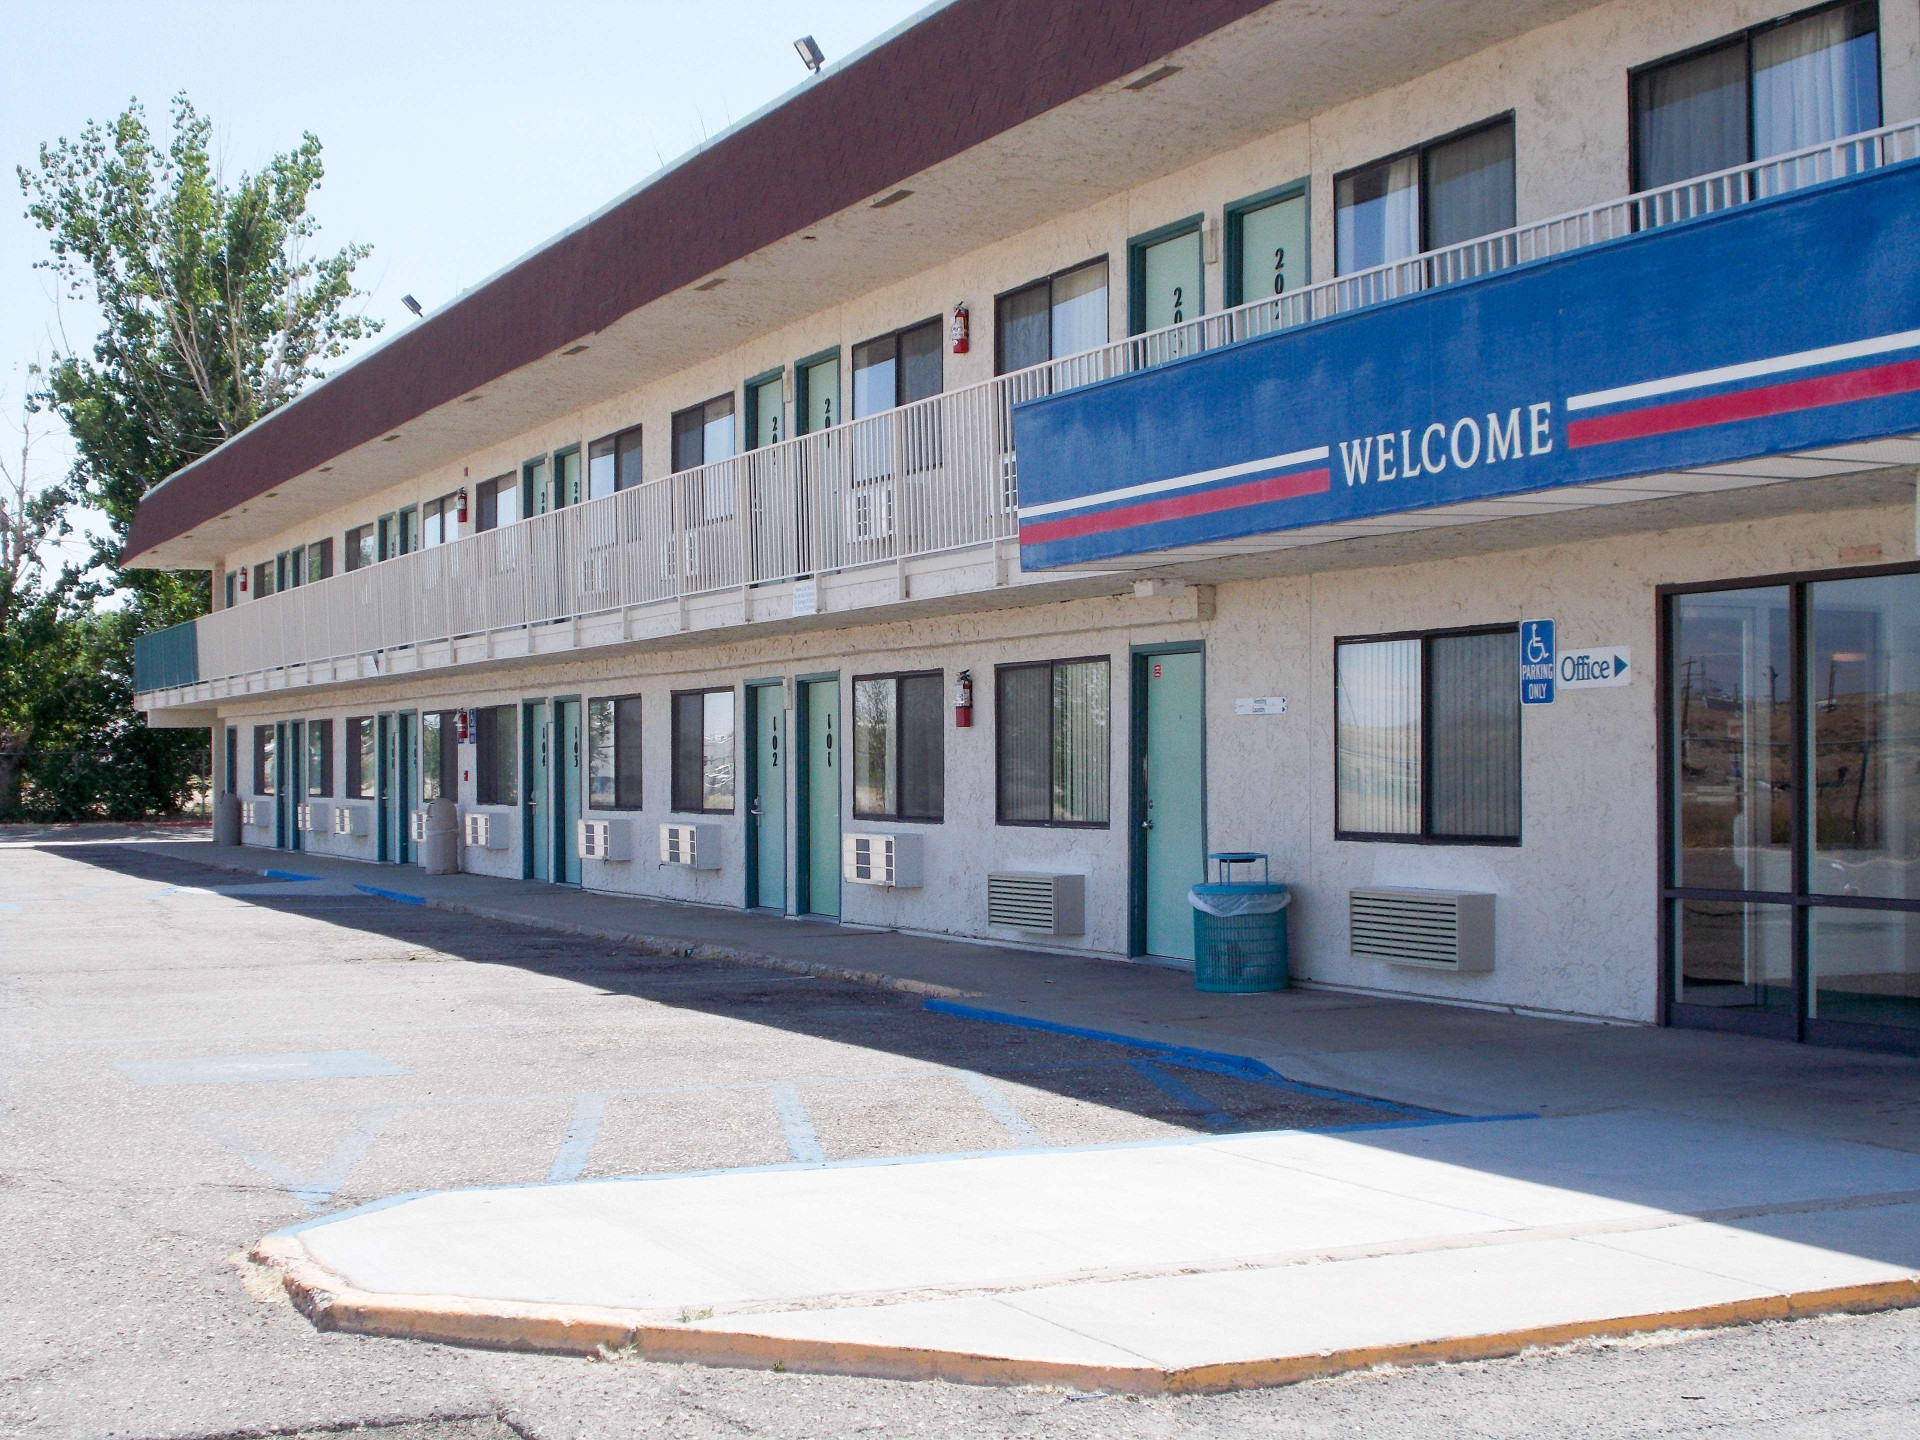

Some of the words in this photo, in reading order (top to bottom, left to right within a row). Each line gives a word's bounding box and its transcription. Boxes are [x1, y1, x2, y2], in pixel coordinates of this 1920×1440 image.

[1339, 402, 1553, 487] WELCOME
[1522, 664, 1554, 680] PARKING
[1561, 655, 1611, 681] Office
[1528, 683, 1547, 699] ONLY
